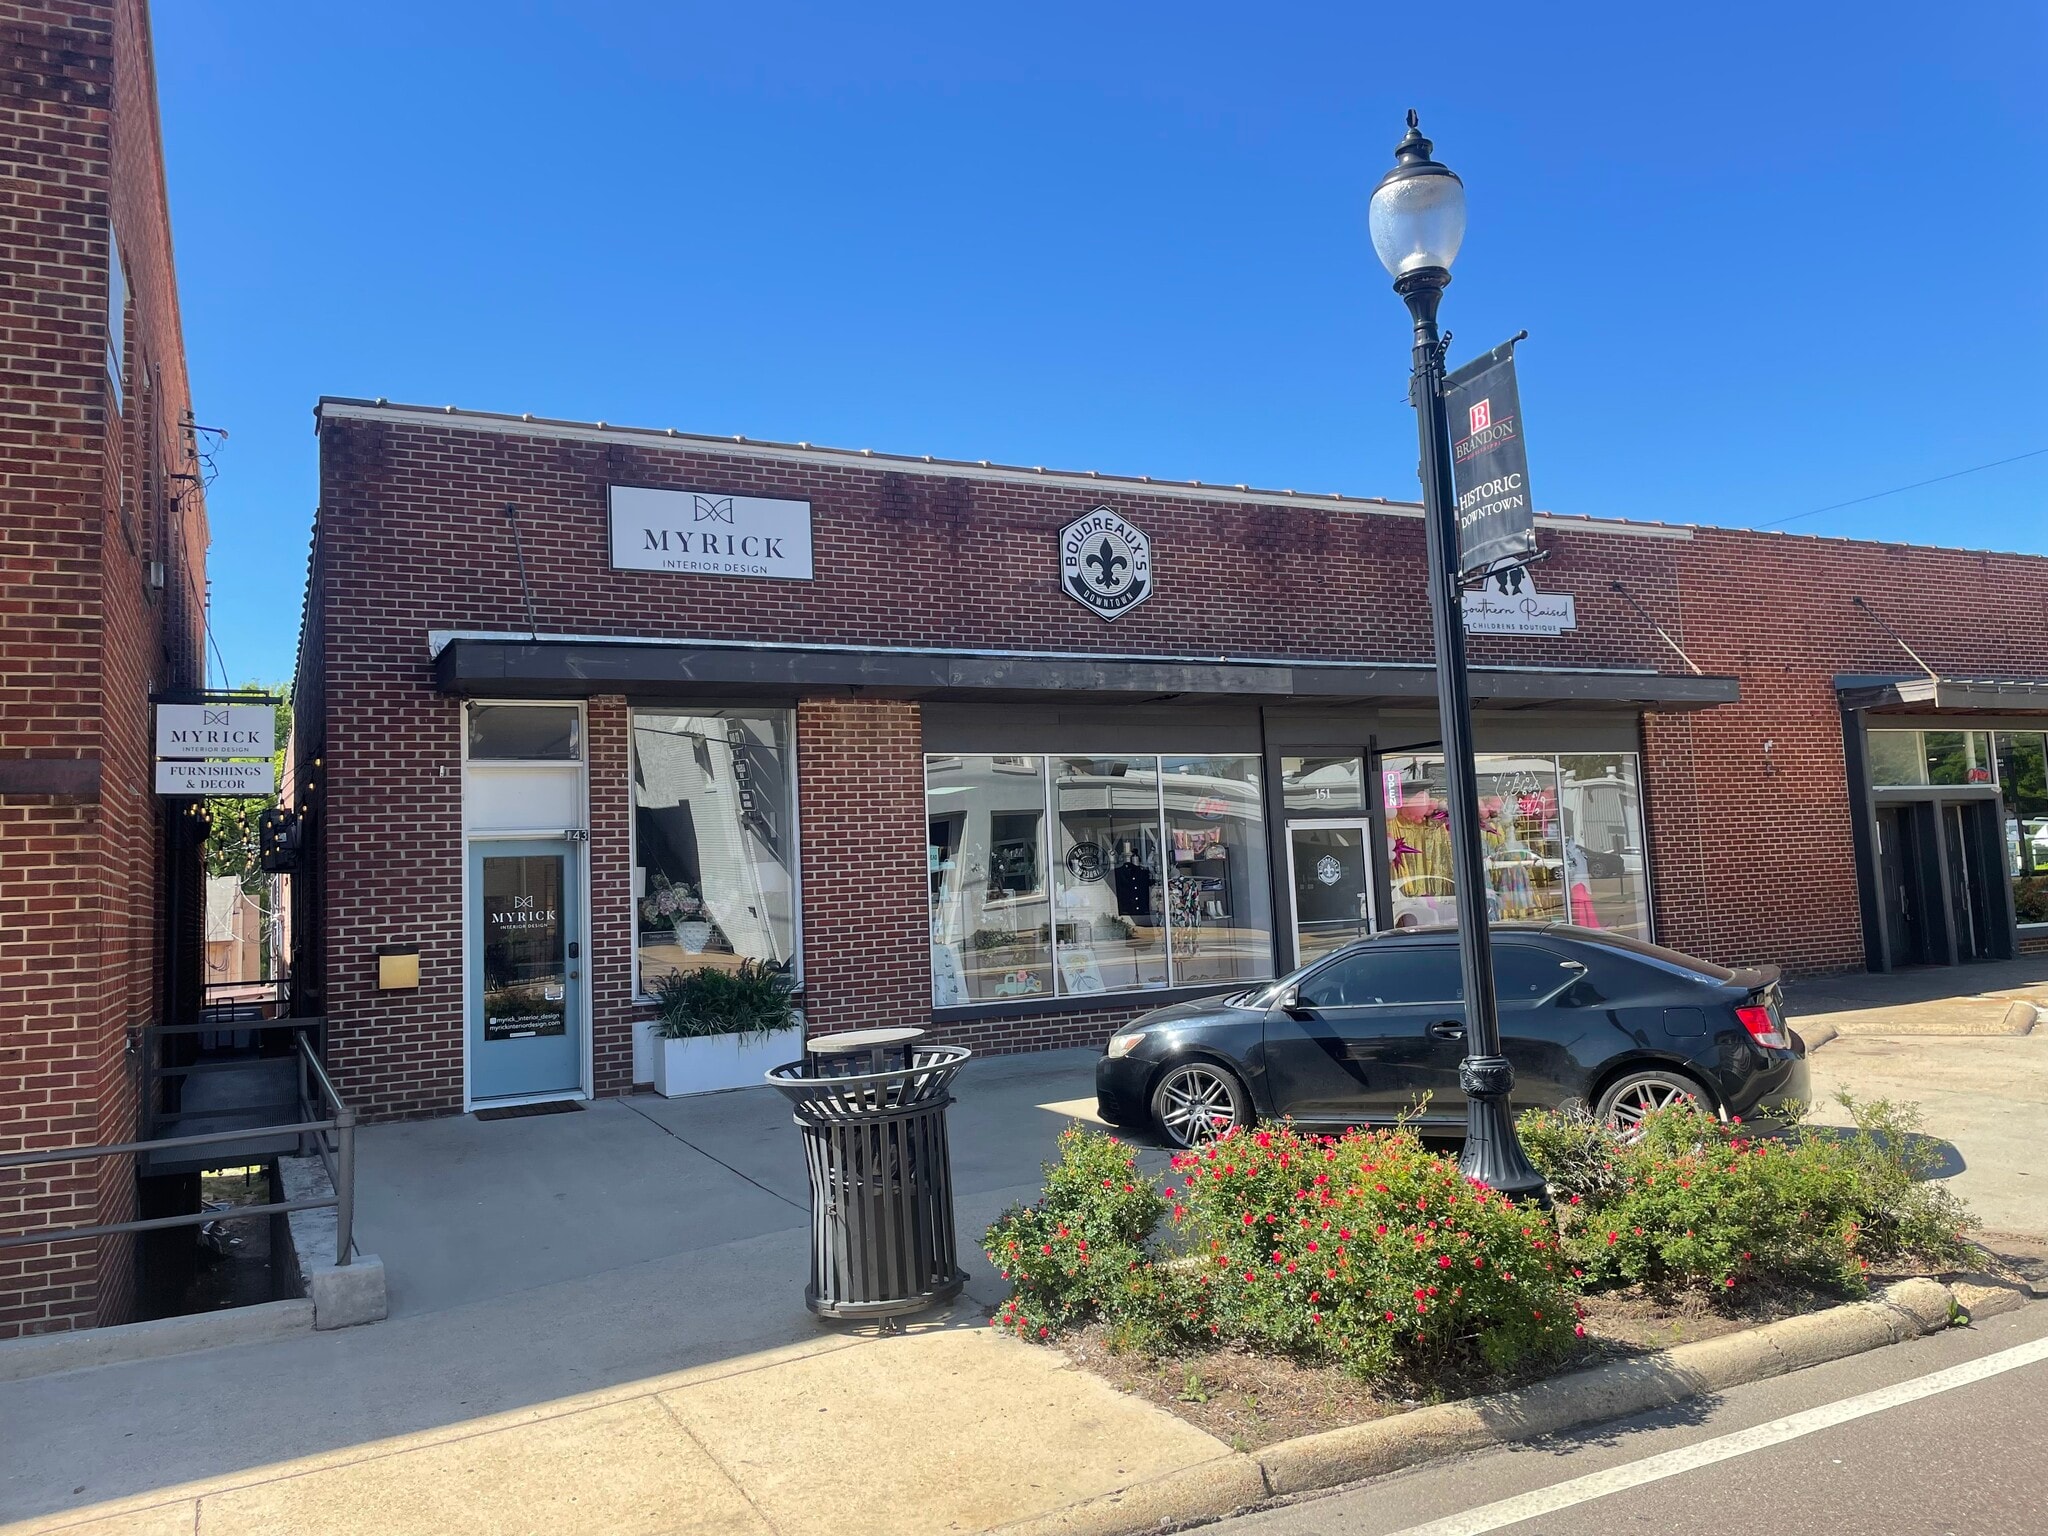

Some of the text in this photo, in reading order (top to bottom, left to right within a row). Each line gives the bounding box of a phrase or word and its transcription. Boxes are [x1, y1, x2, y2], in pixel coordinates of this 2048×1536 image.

[1455, 420, 1514, 459] BRANDON
[1459, 473, 1522, 511] HISTORIC
[1461, 494, 1524, 529] DOWNTOWN
[643, 528, 786, 559] MYRICK
[1065, 517, 1148, 571] BOUDREAUX'S
[662, 559, 769, 574] INTERIOR DESIGN
[1083, 589, 1134, 608] DOWNTOWN
[1519, 597, 1569, 622] Raised
[1472, 622, 1557, 632] CHILDRENS BOUTIQUE
[170, 730, 261, 743] MYRICK
[170, 766, 261, 776] FURNISHINGS
[186, 779, 245, 789] & DECOR
[1387, 773, 1397, 806] OPEN
[1315, 788, 1331, 800] 151
[567, 830, 588, 841] 143
[491, 910, 556, 924] MYRICK
